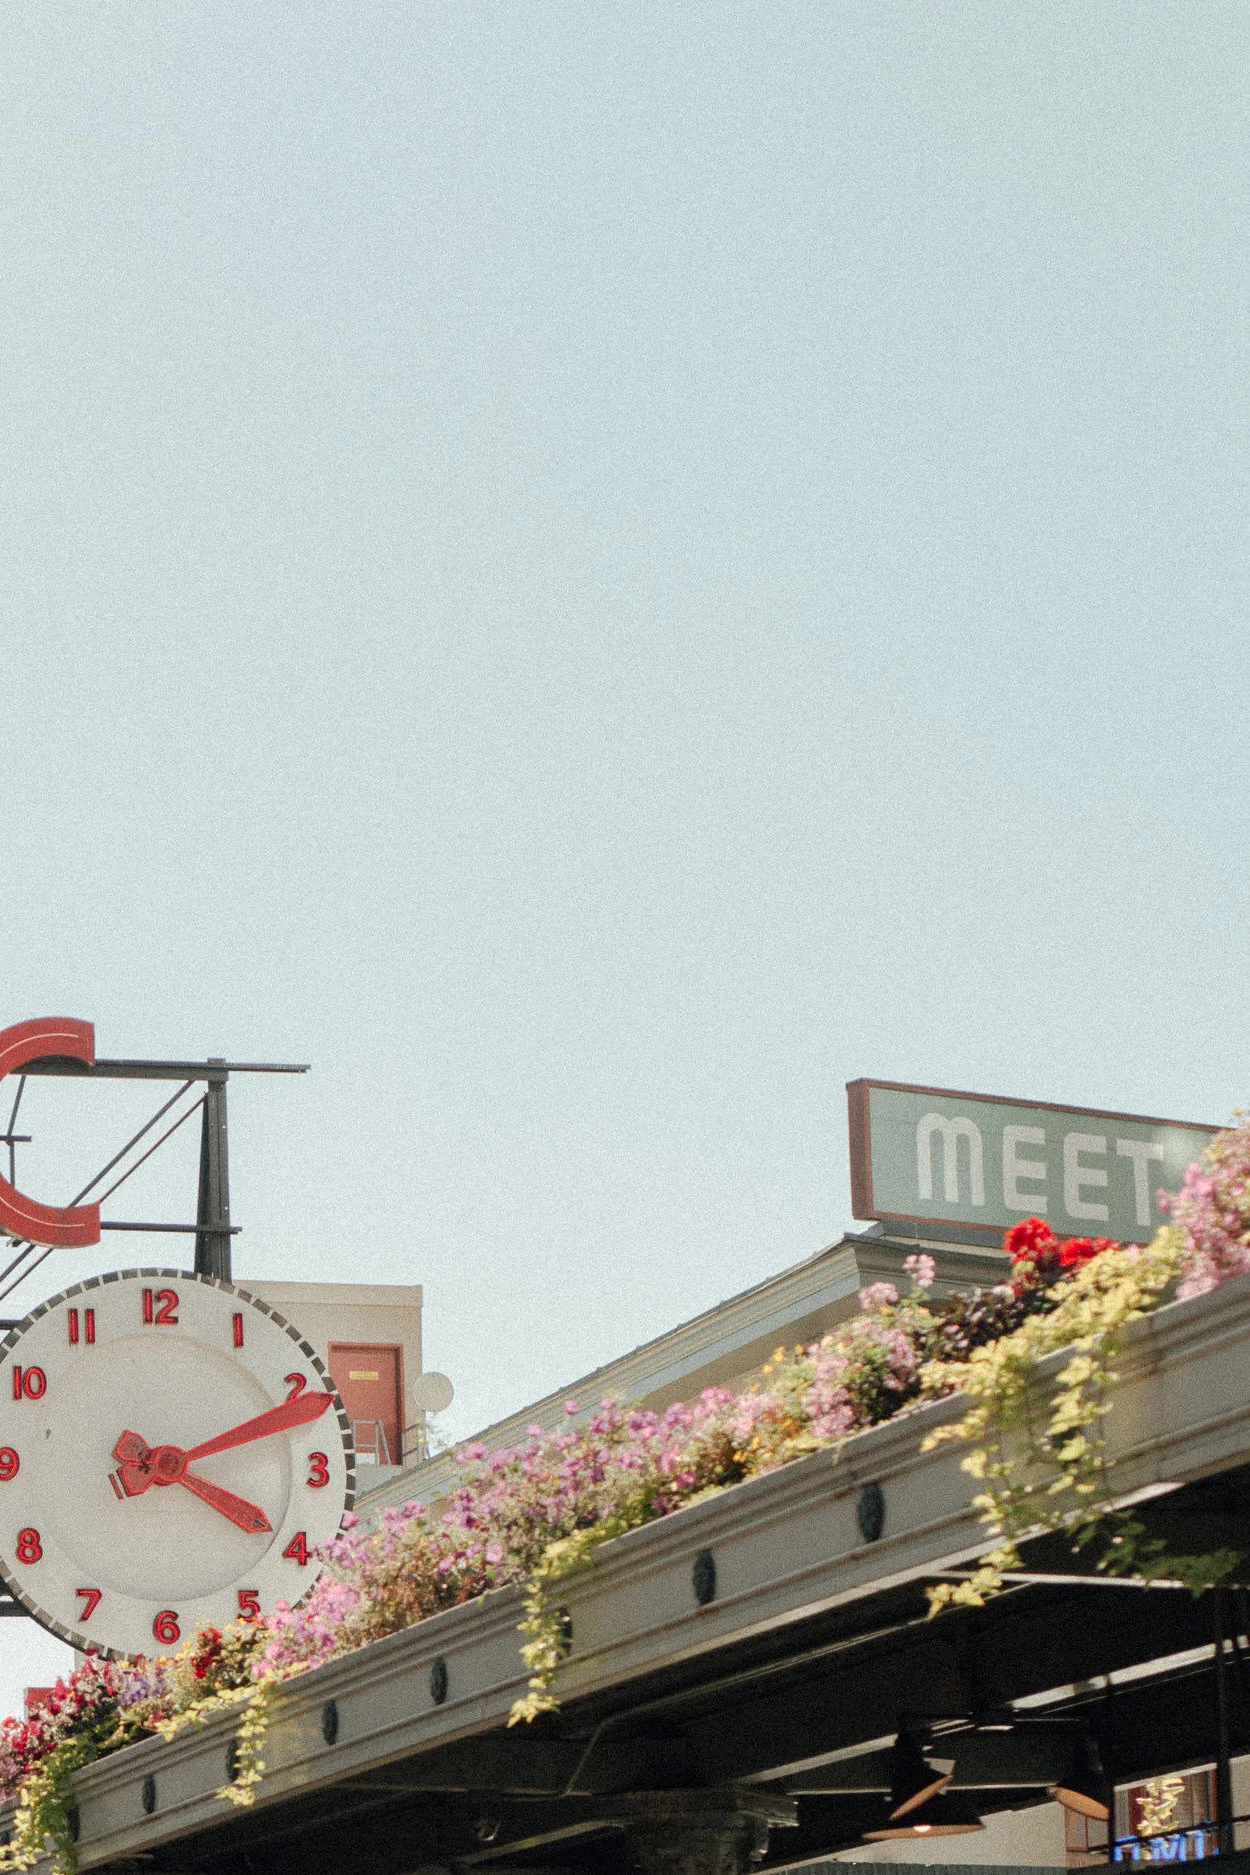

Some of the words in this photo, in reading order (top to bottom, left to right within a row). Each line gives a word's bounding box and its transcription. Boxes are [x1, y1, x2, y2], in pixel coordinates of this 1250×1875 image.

[916, 1112, 1164, 1227] MEET
[142, 1288, 179, 1324] 12
[67, 1308, 96, 1344] 11
[232, 1313, 244, 1348] 1
[12, 1365, 48, 1400] 10
[306, 1452, 331, 1488] 3
[15, 1527, 43, 1564] 8
[283, 1532, 312, 1567] 4
[76, 1588, 104, 1621] 7
[238, 1589, 261, 1623] 5
[153, 1610, 181, 1646] 6
